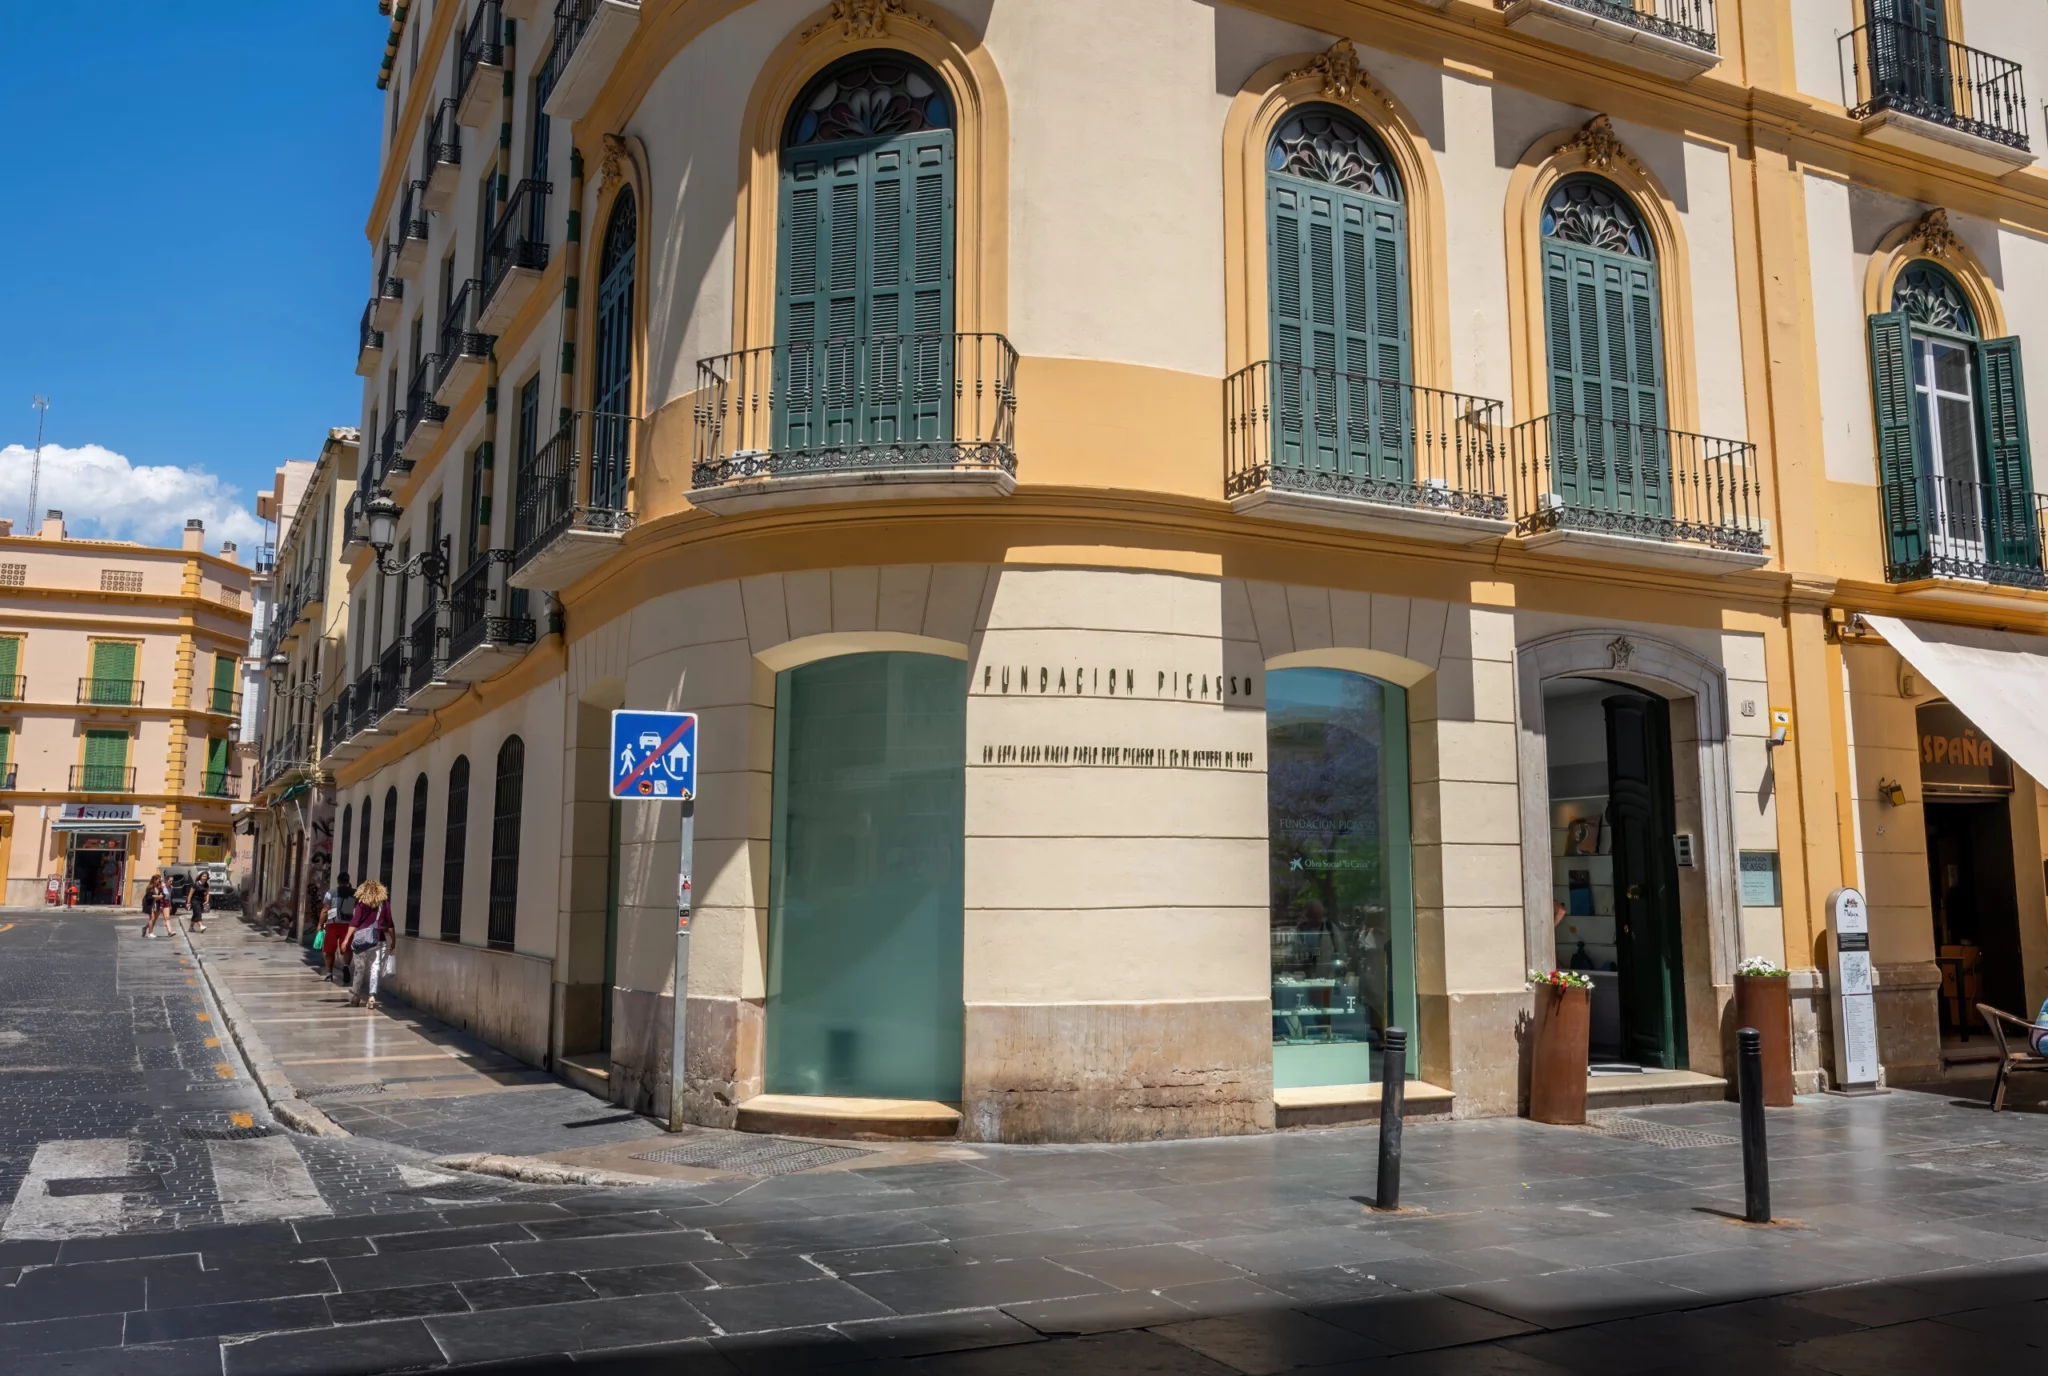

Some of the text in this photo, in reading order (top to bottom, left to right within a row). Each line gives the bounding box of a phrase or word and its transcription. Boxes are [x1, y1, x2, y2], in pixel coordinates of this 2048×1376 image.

[984, 665, 1252, 701] FUNDACION PICASSO
[85, 810, 131, 820] SHOP
[1339, 820, 1376, 831] PICASSO
[1305, 860, 1322, 868] Obra
